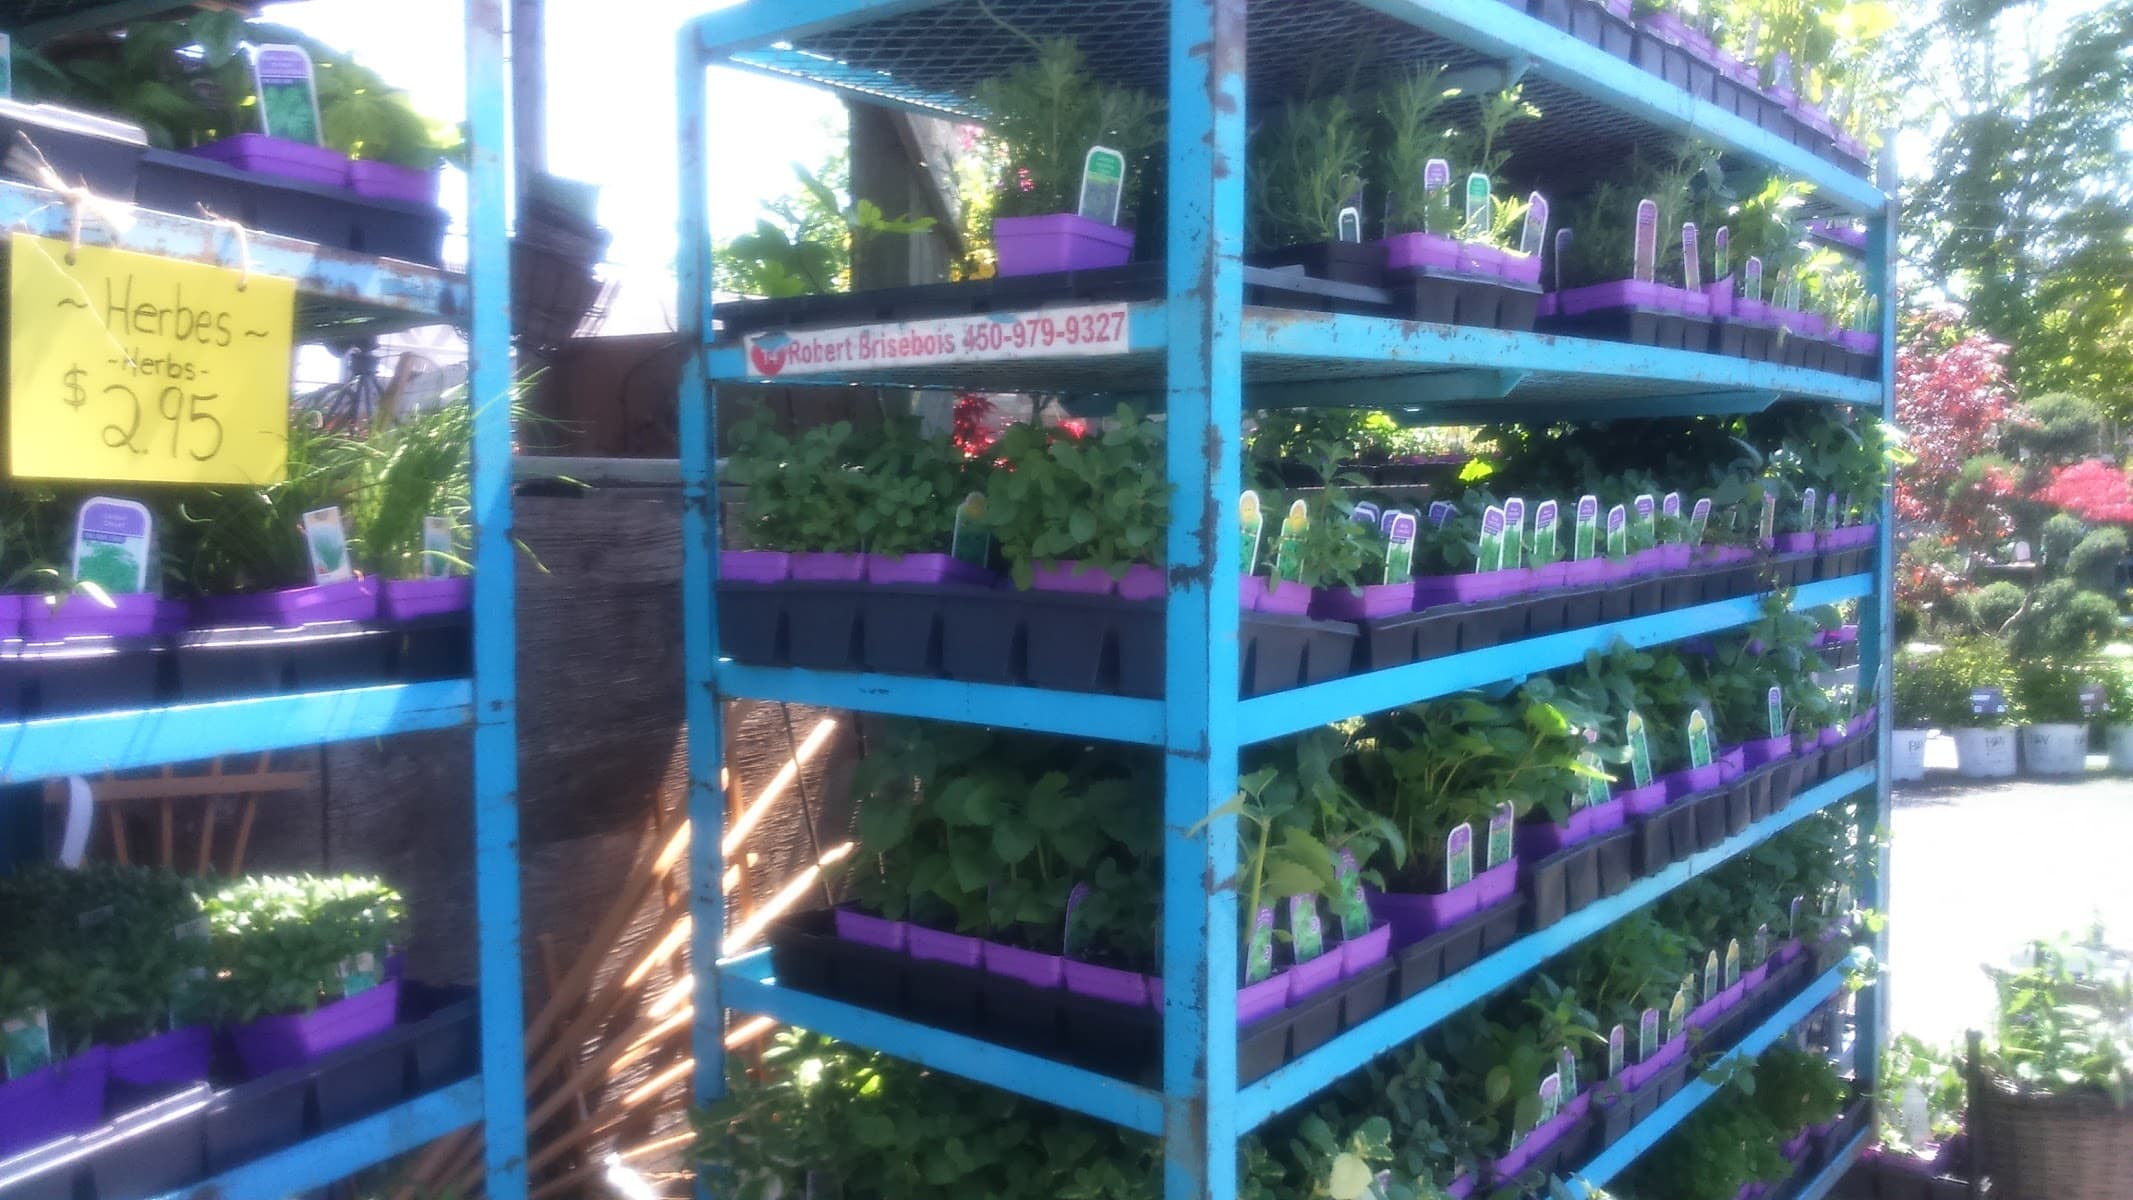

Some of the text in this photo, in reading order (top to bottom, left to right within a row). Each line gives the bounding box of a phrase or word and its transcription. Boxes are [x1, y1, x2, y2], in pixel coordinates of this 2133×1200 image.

[105, 273, 231, 347] Herbes
[788, 338, 853, 365] Robert
[857, 329, 955, 360] Brisebois
[962, 312, 1126, 352] 450-979-9327
